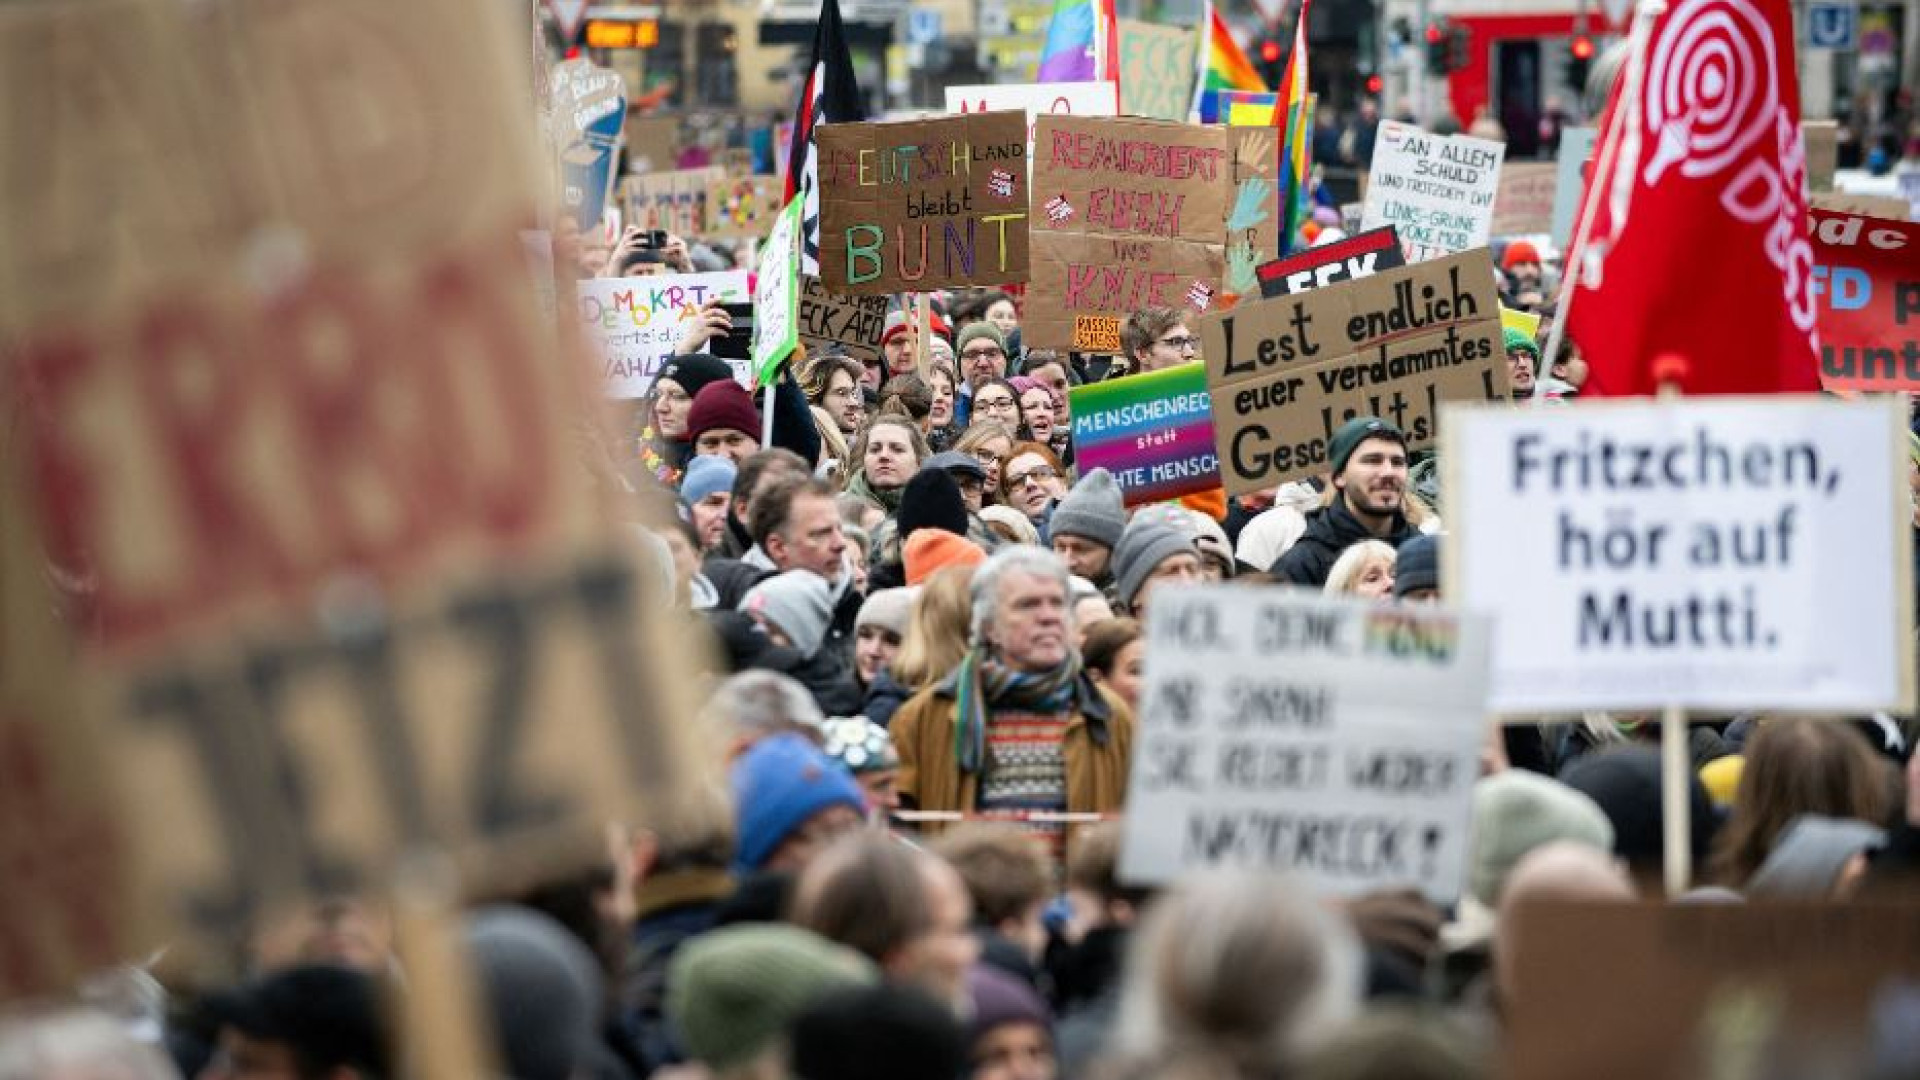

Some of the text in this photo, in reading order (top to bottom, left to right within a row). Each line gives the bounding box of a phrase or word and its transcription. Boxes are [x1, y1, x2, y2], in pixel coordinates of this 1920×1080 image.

[1816, 8, 1846, 42] U
[1403, 138, 1496, 171] AN ALLEM
[1415, 160, 1479, 184] SCHULD
[907, 187, 973, 219] bleibt
[845, 212, 1026, 285] BUNT
[1064, 263, 1178, 312] KNIE
[1222, 265, 1477, 376] Lest endlich
[1234, 377, 1303, 415] euer
[1317, 326, 1491, 393] verdammtes
[1137, 427, 1177, 449] statt
[1512, 428, 1841, 499] Fritzchen,
[1557, 507, 1795, 568] hör auf
[1578, 589, 1779, 650] Mutti.
